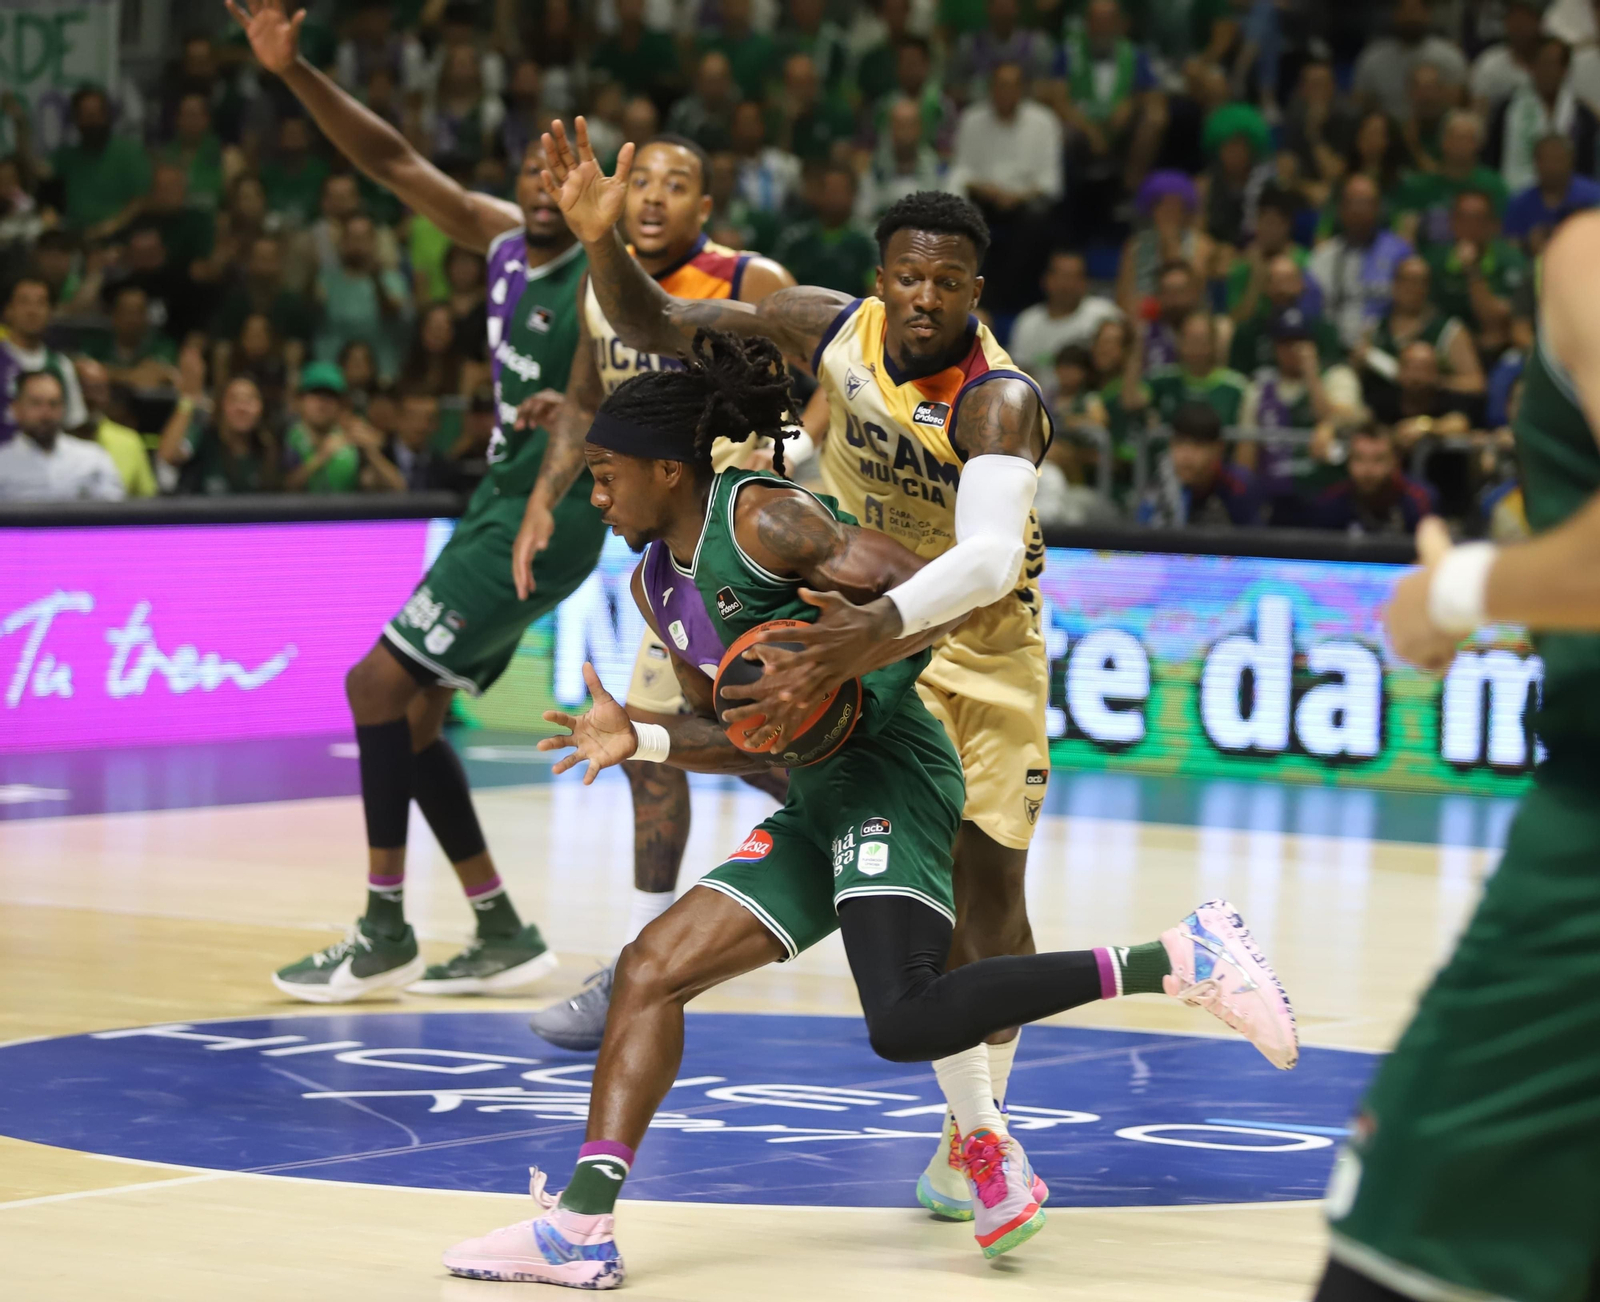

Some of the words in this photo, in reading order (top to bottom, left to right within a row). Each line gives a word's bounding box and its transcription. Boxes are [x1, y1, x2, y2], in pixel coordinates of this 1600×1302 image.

[0, 10, 104, 88] DE
[914, 413, 945, 426] endesa
[917, 405, 931, 416] liga
[846, 409, 961, 493] UCAM
[0, 590, 94, 708] Tu
[1201, 593, 1383, 759] da
[1027, 774, 1044, 784] acb
[863, 822, 884, 834] acb
